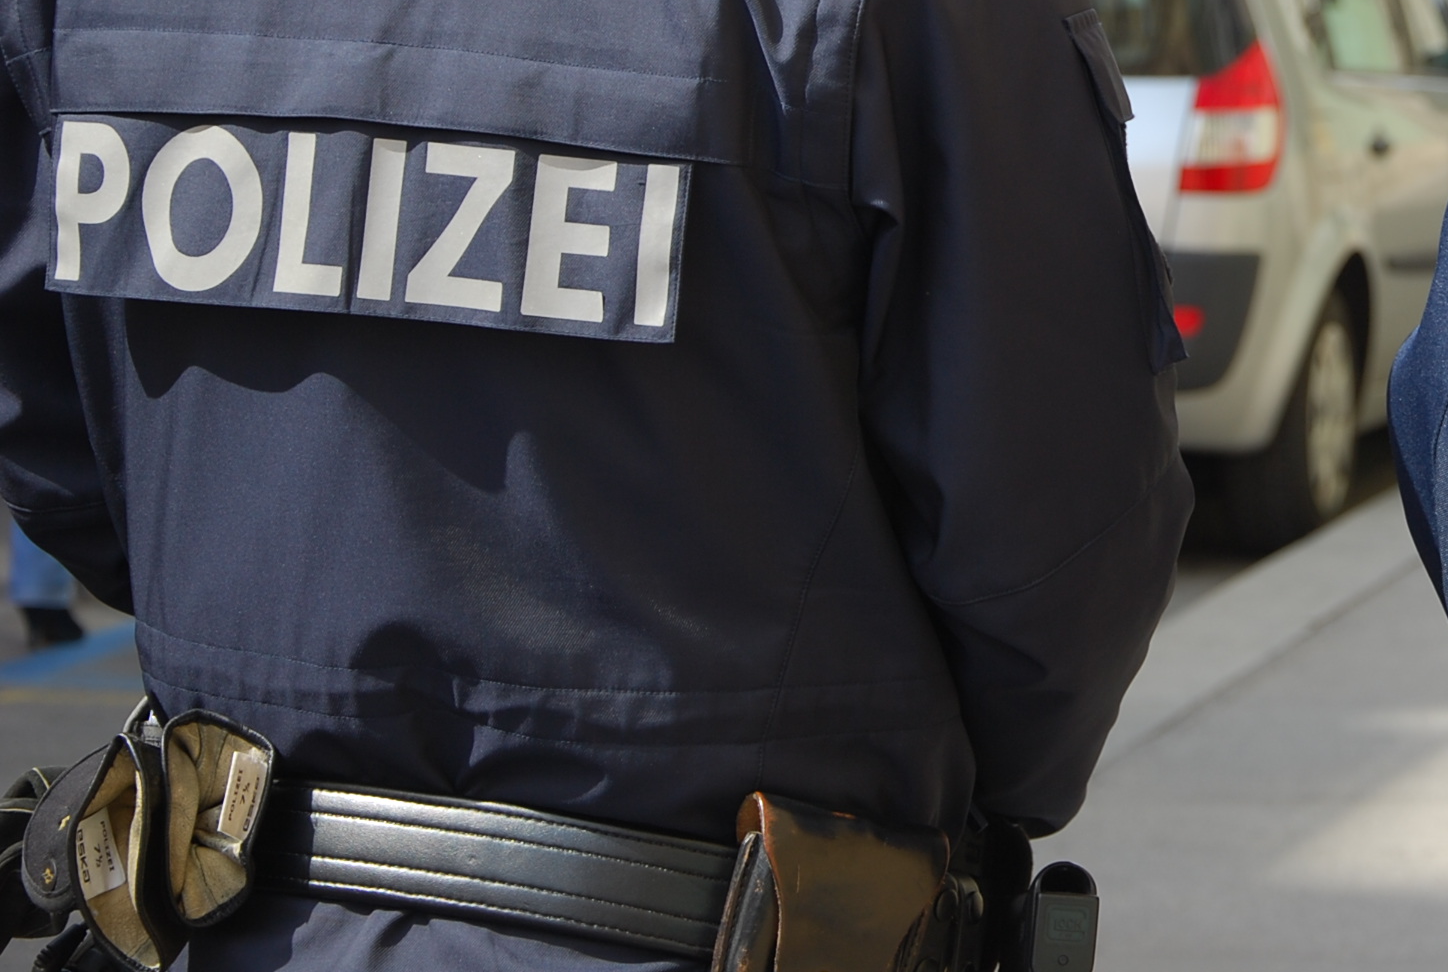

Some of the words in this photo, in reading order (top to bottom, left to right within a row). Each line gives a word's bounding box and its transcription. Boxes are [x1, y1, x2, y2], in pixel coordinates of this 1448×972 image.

[53, 120, 680, 327] POLIZEI
[227, 769, 243, 822] POLIZEI
[100, 819, 115, 873] POLIZEI
